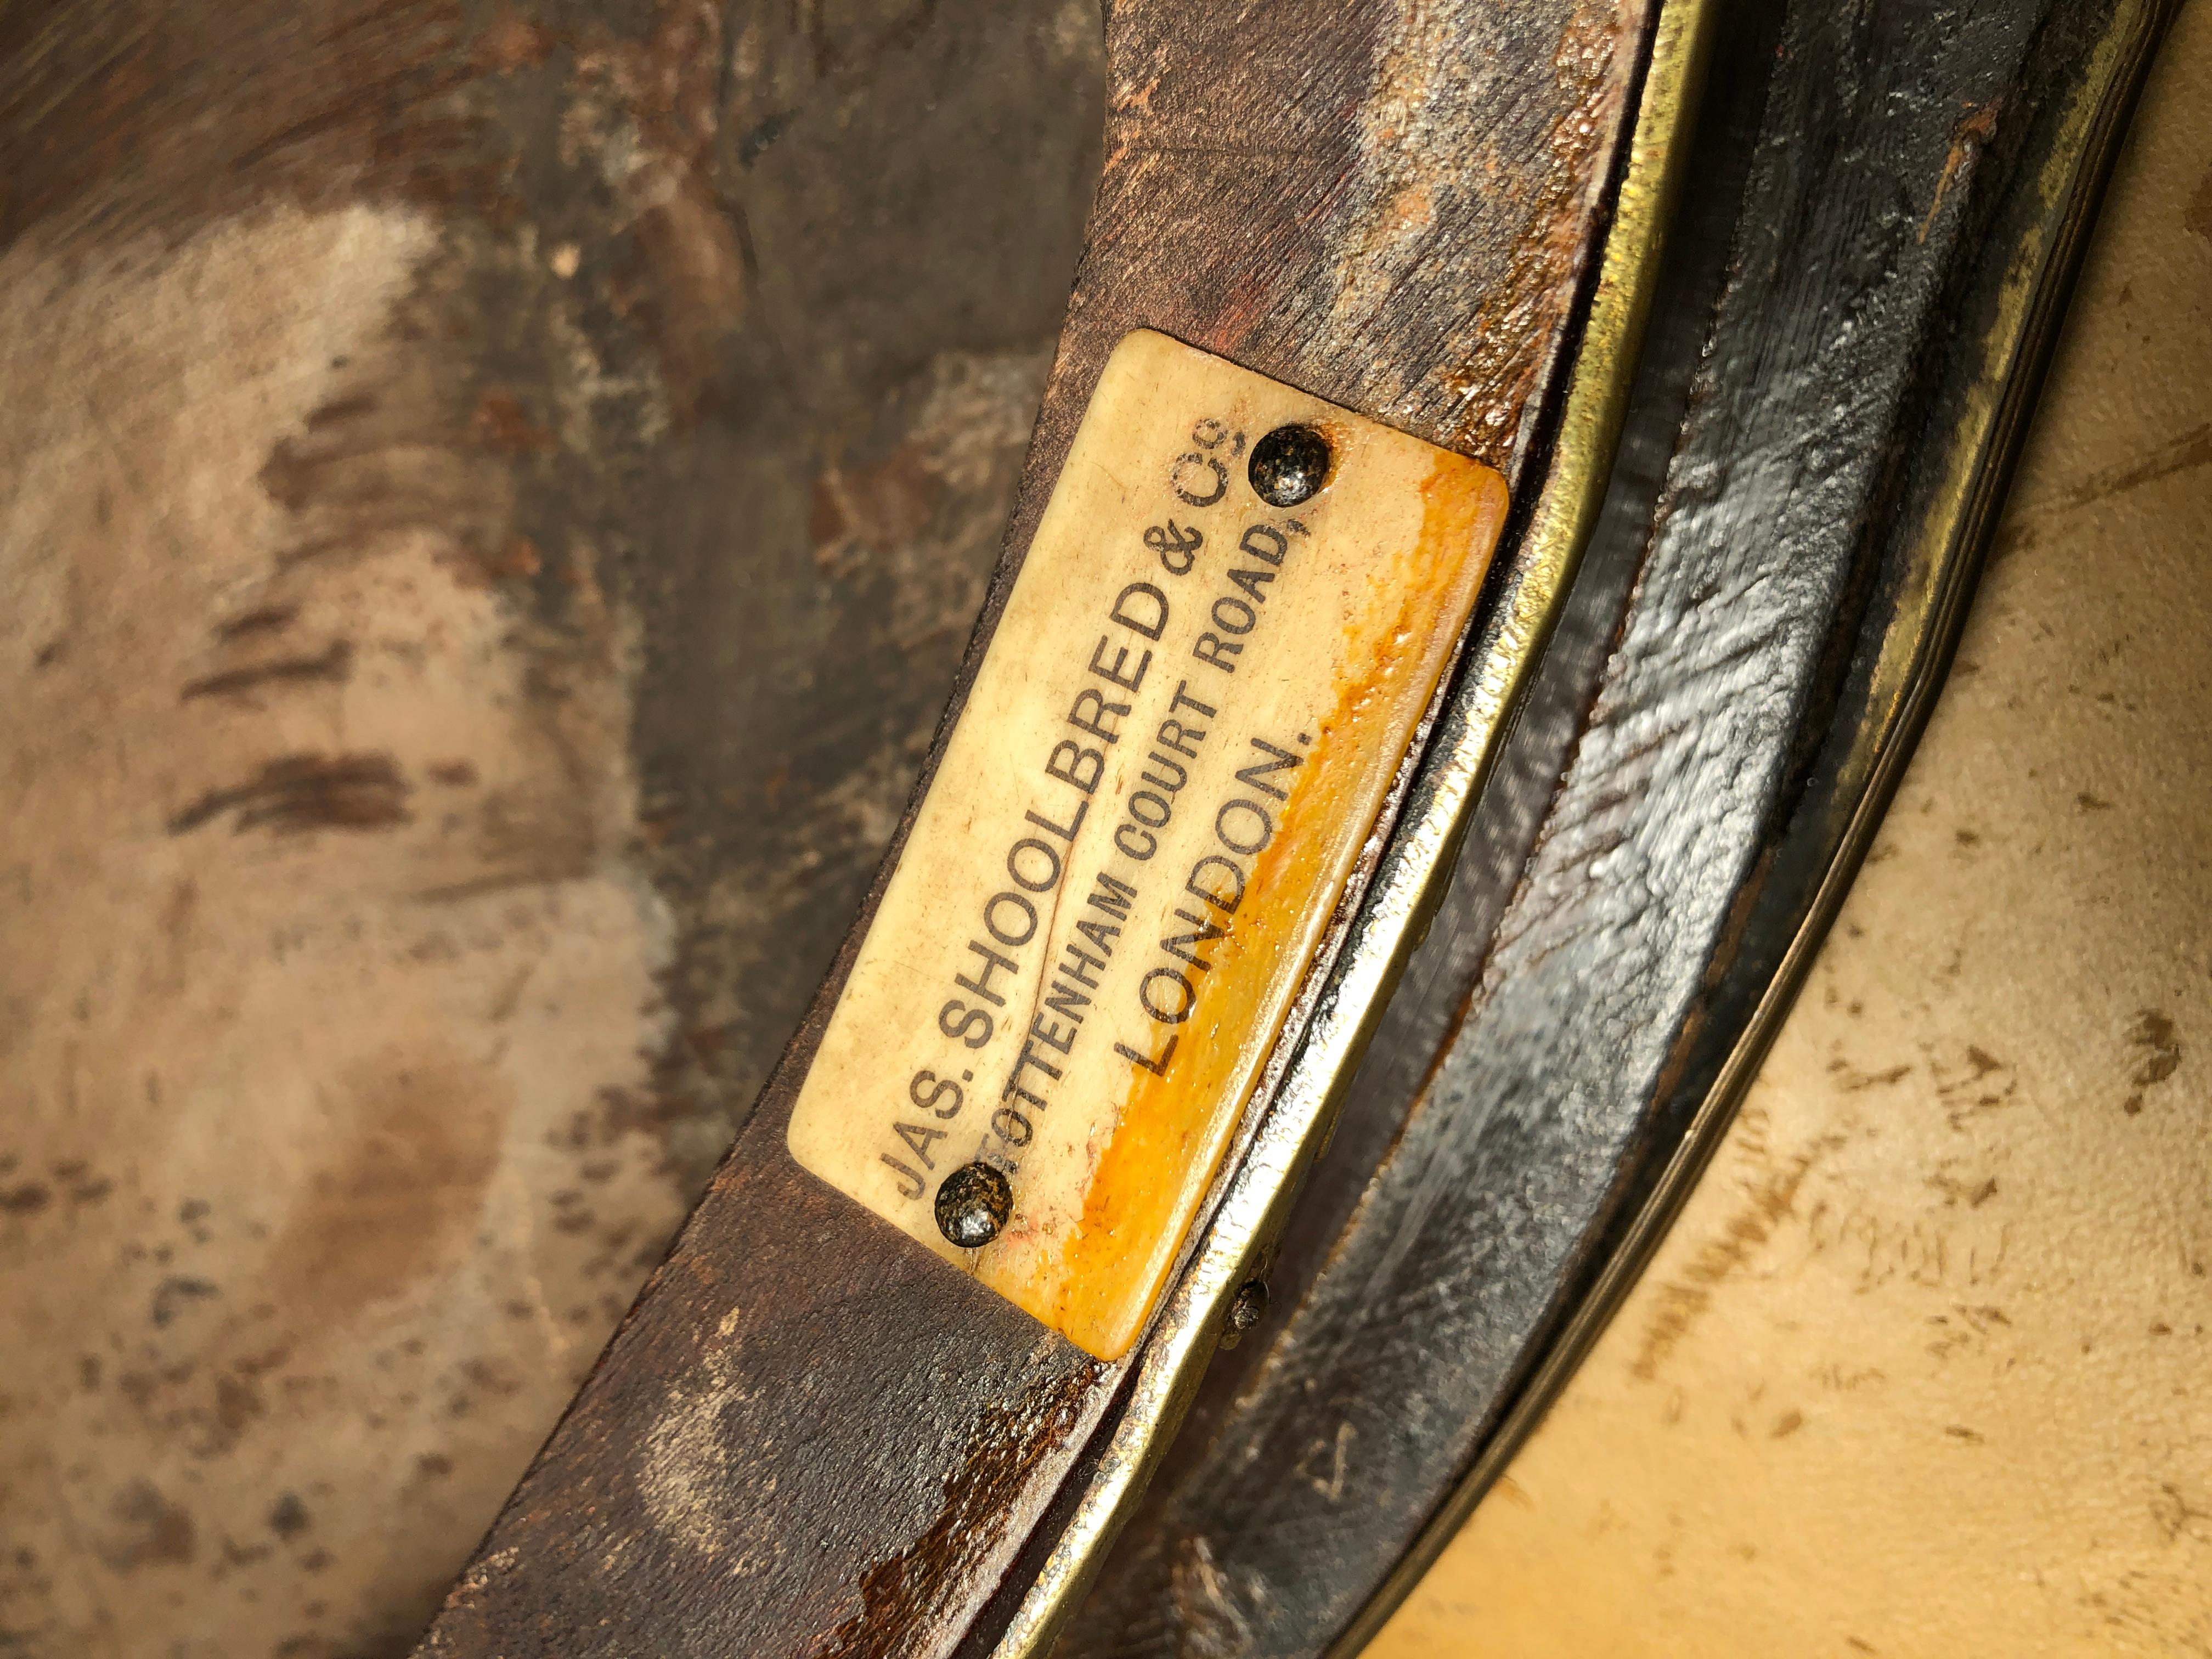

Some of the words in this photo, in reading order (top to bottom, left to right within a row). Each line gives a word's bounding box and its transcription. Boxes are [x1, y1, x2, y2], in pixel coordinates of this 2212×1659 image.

[878, 1069, 974, 1200] JAS.
[939, 582, 1169, 1049] SHOOLBRED
[1143, 518, 1203, 576] &
[1114, 679, 1217, 861] COURT
[1192, 518, 1311, 674] ROAD,
[1113, 732, 1312, 1076] LONDON.
